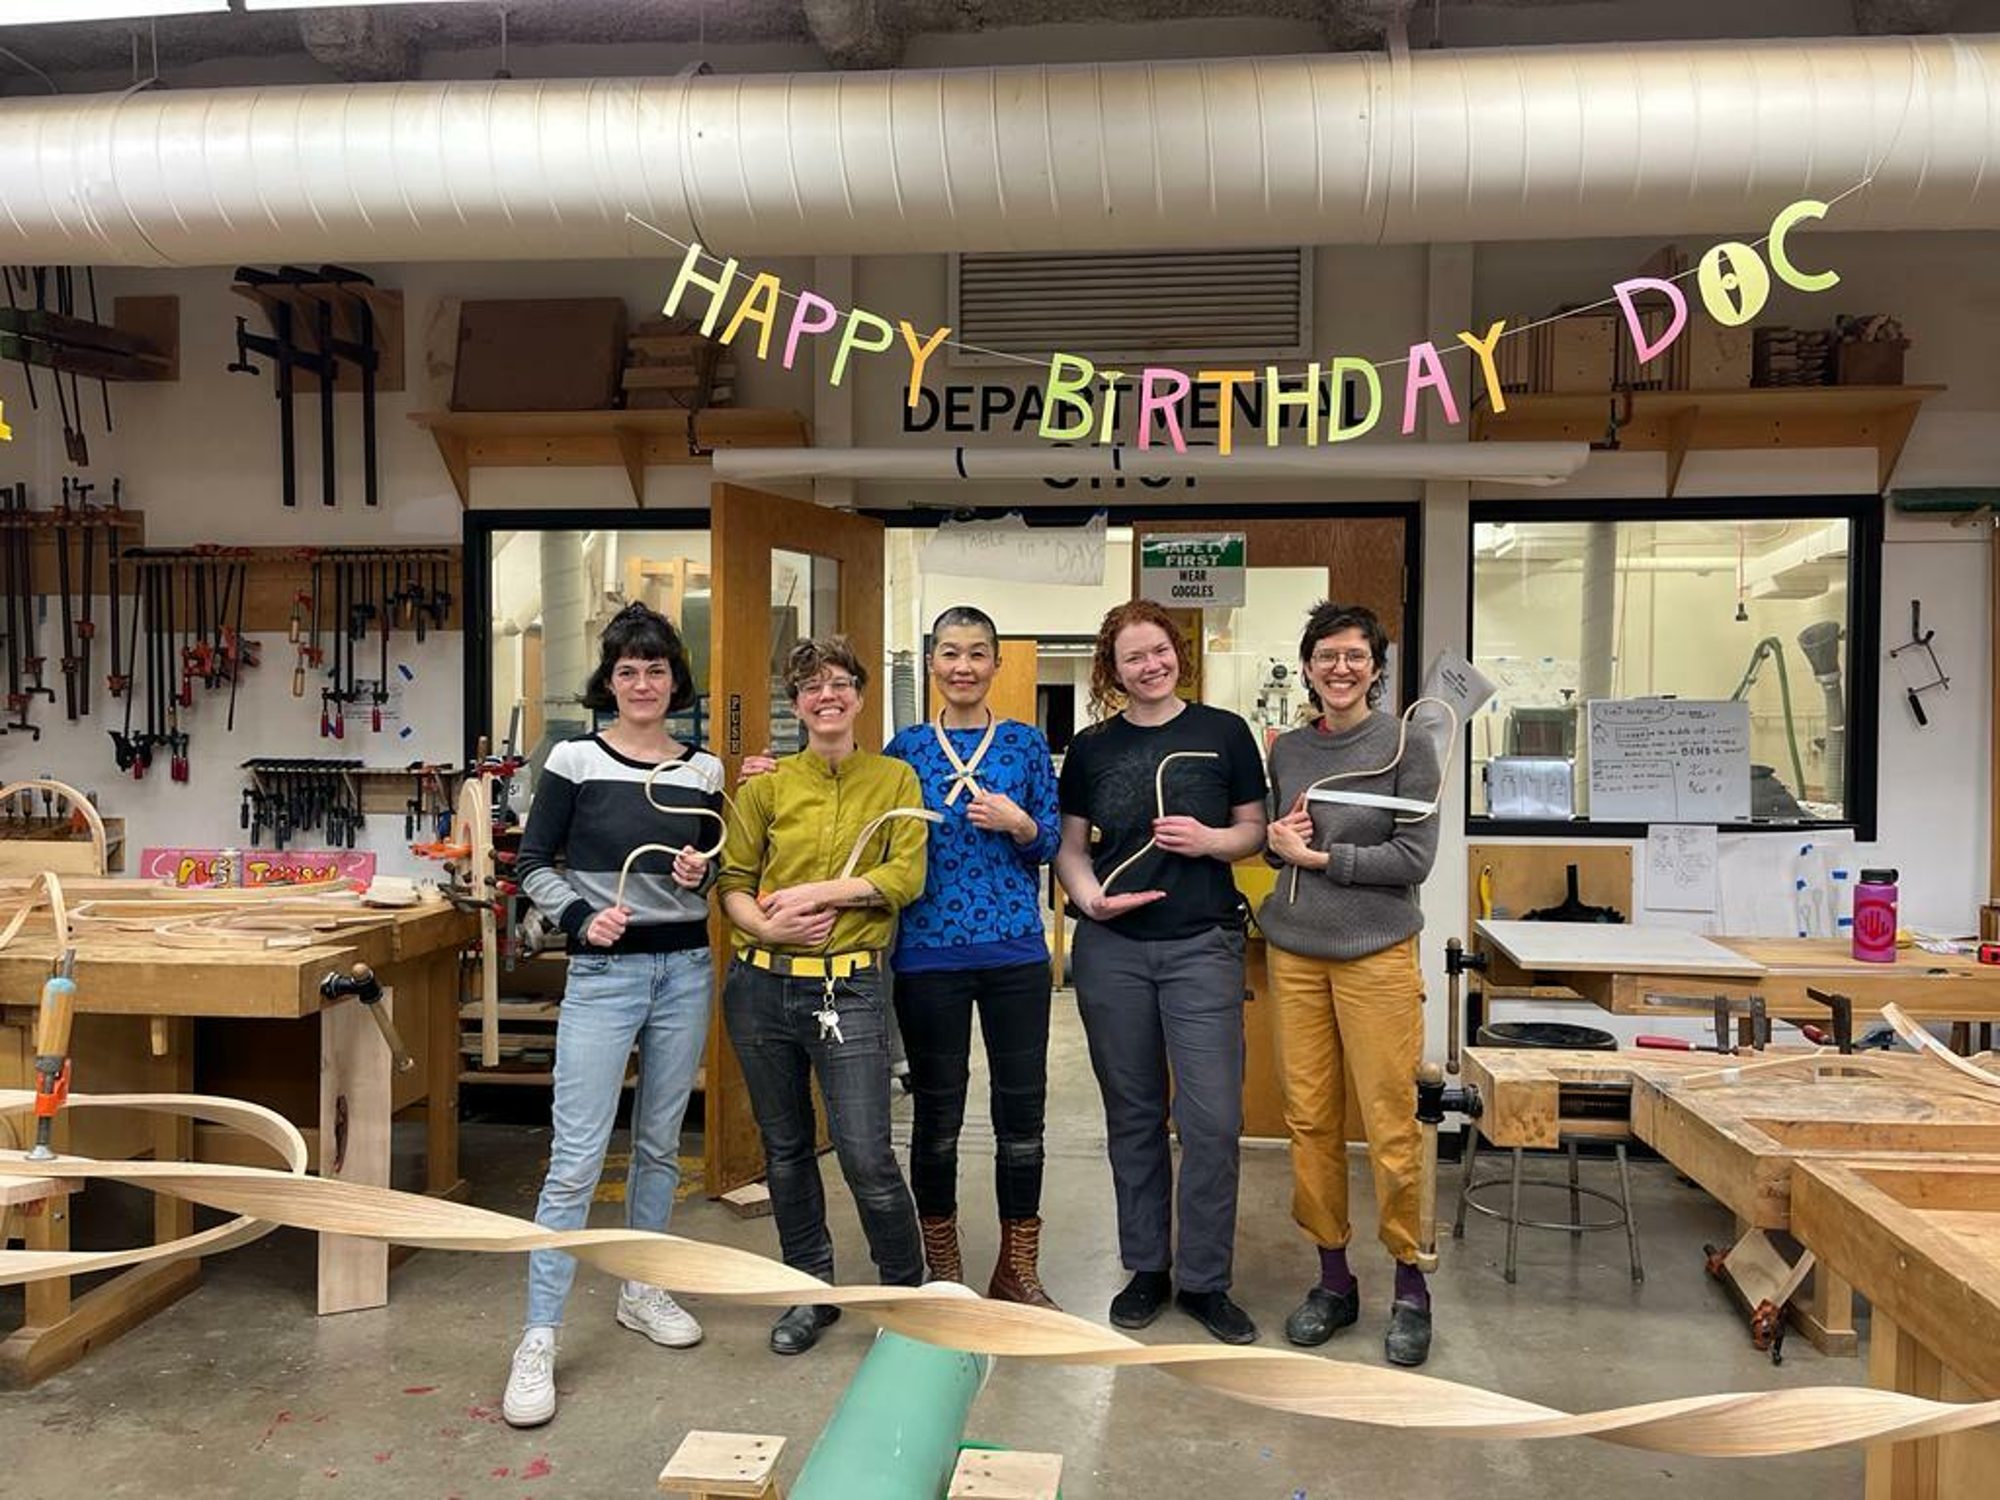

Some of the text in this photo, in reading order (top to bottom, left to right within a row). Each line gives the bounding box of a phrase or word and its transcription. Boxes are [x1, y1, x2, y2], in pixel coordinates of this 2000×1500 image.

[662, 200, 1841, 455] HAPPY BIRTHDAY DOC
[1052, 540, 1103, 574] DAY
[1165, 554, 1220, 567] FIRST
[1179, 570, 1207, 582] WEAR
[1171, 585, 1214, 598] GOGGLES
[731, 696, 740, 753] PUSH
